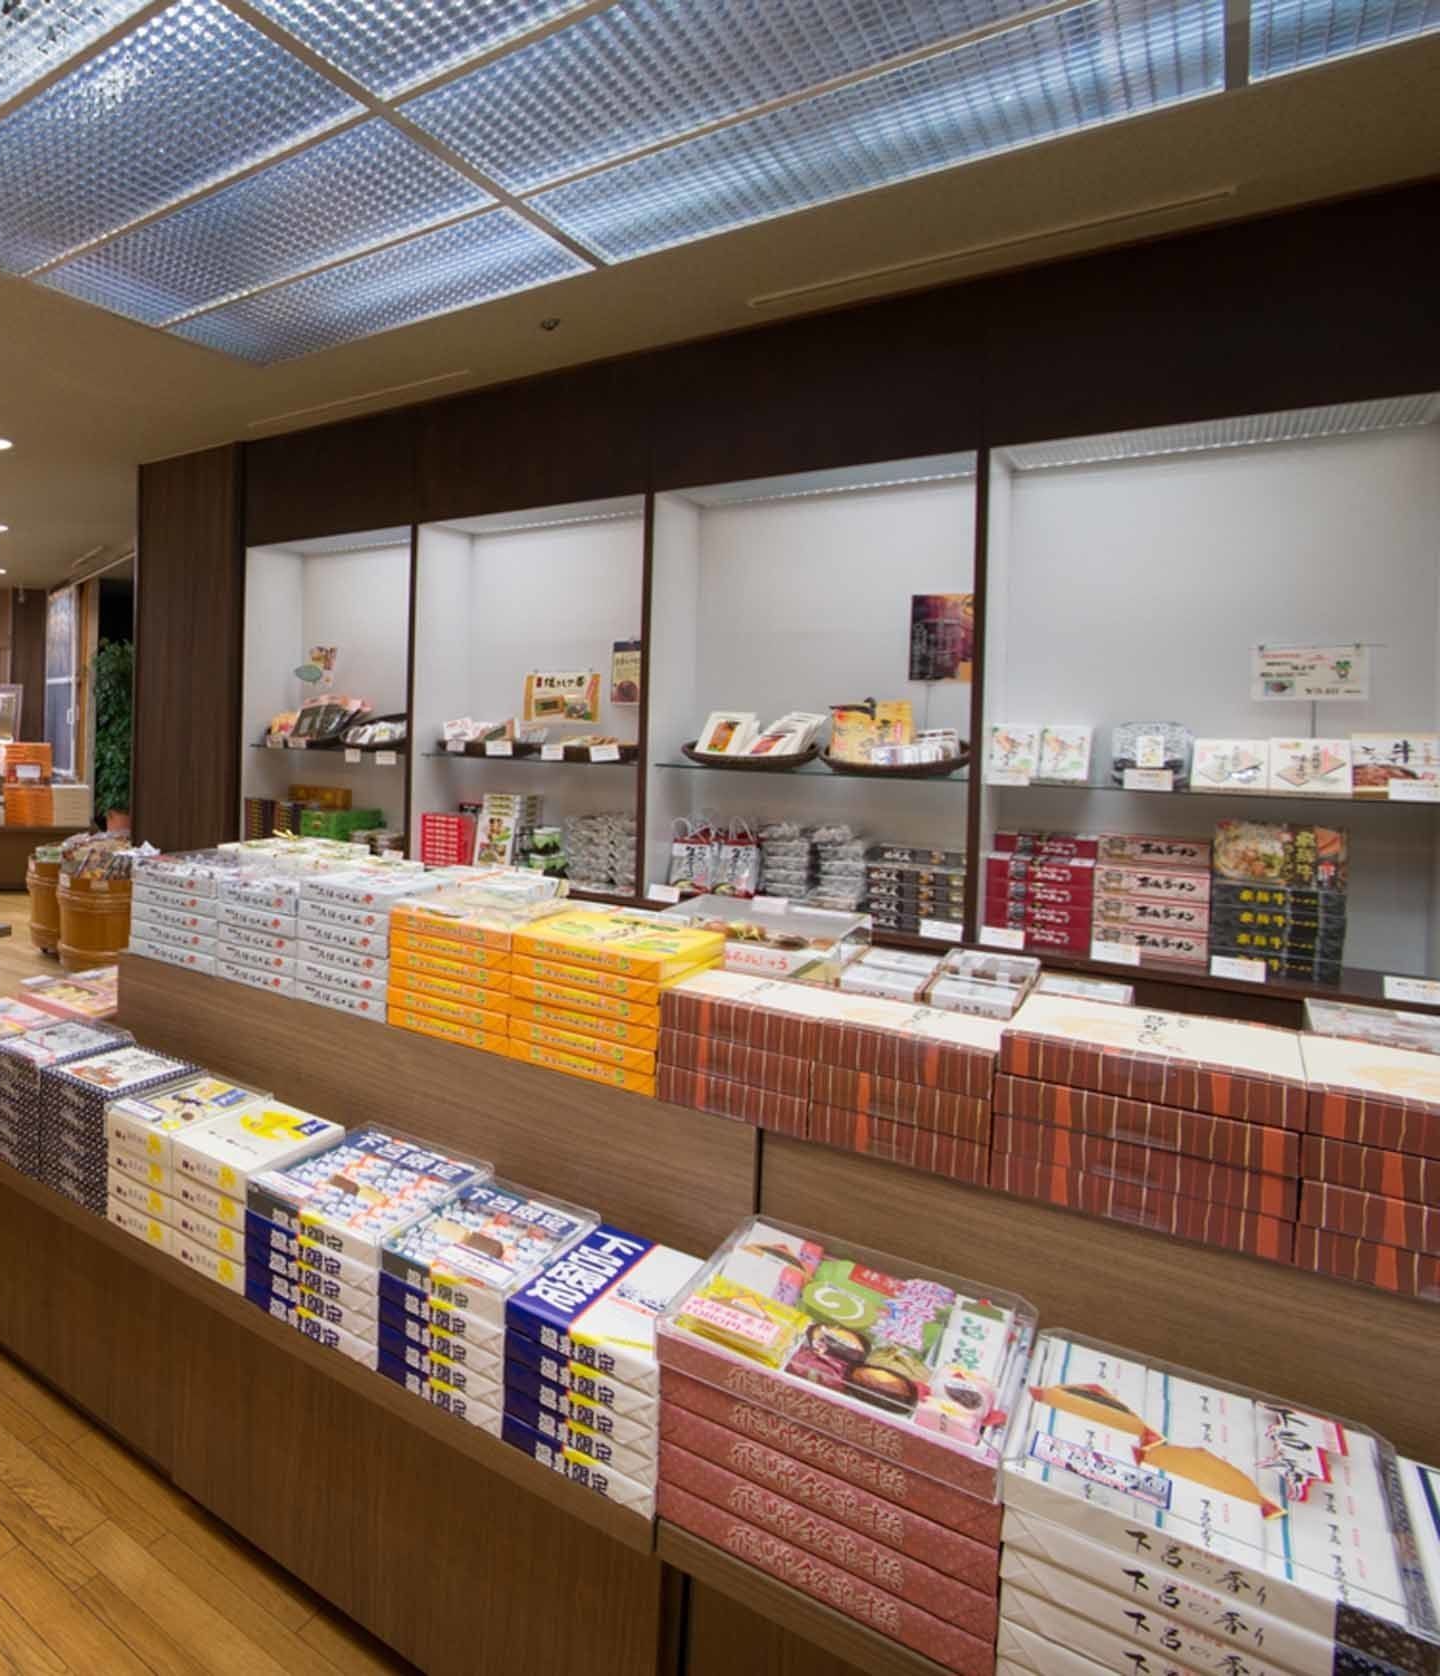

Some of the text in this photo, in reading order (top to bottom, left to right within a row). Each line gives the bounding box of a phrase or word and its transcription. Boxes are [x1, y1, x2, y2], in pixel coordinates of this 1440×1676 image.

[359, 1132, 462, 1181] 下呂限定
[468, 1187, 570, 1233] 下呂限定
[525, 1231, 644, 1313] 下呂限定
[1124, 1529, 1267, 1604] 下呂の香り
[1122, 1568, 1265, 1647] 下呂の香り
[1123, 1610, 1265, 1676] 下呂の香
